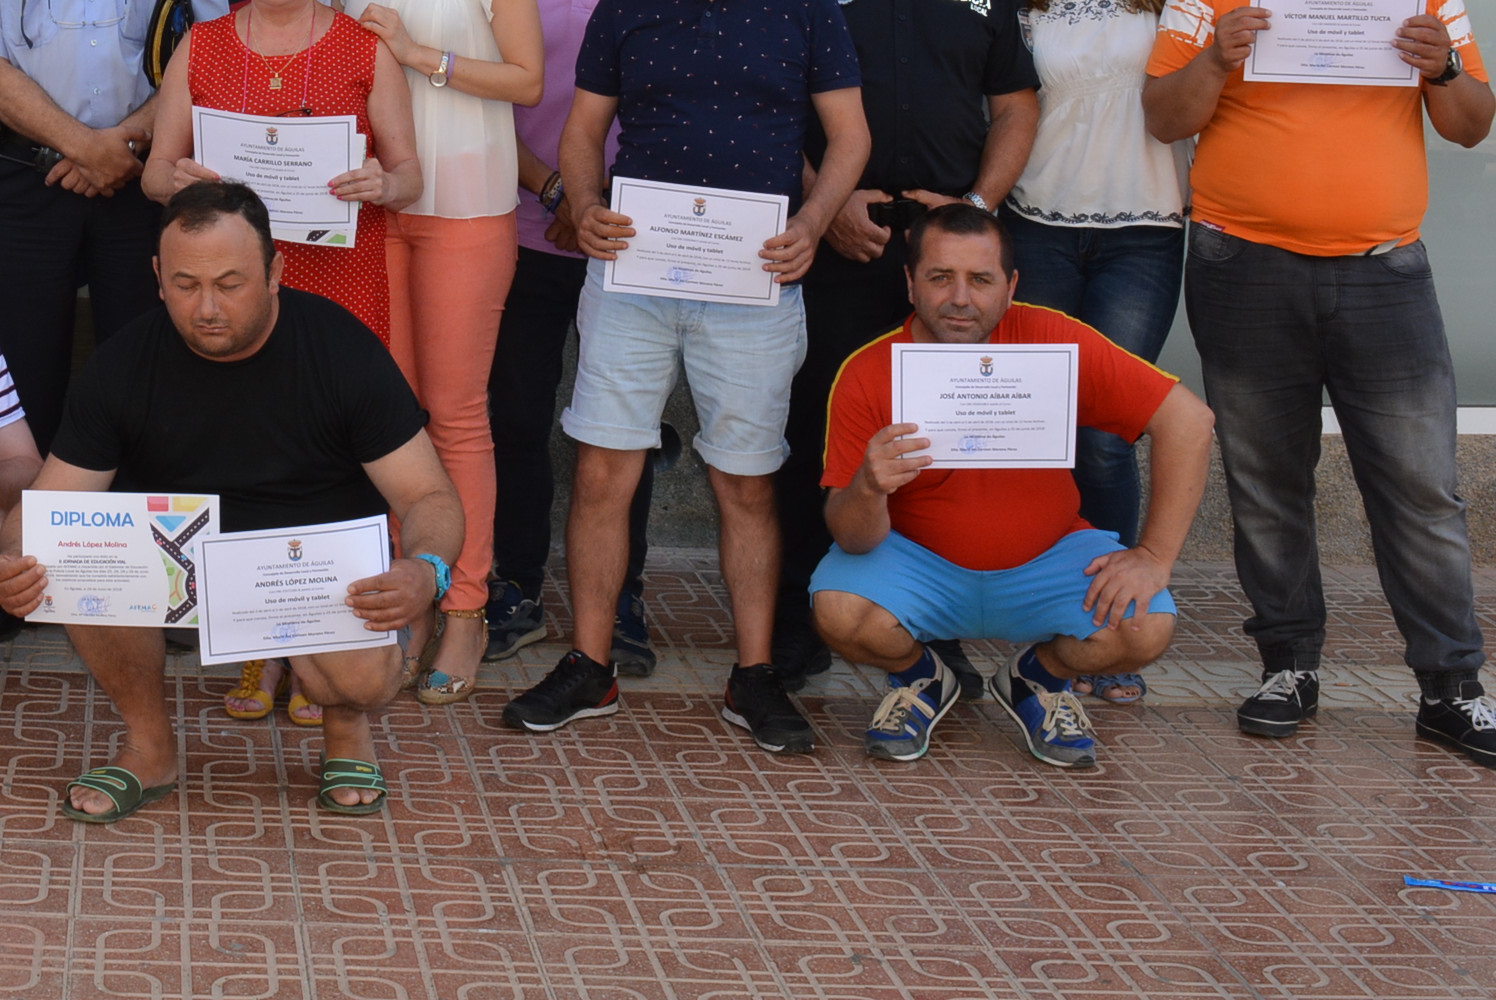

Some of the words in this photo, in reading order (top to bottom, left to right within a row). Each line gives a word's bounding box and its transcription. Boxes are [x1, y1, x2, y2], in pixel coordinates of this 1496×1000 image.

[970, 3, 988, 17] LOCAL
[234, 155, 254, 163] MARÍA
[254, 158, 283, 166] CARRILLO
[283, 159, 313, 168] SERRANO
[650, 226, 680, 235] ALFONSO
[680, 229, 713, 239] MARTÍNEZ
[714, 233, 744, 242] ESCÁMEZ
[940, 392, 956, 400] JOSÉ
[51, 511, 135, 528] DIPLOMA
[82, 541, 103, 549] López
[255, 579, 284, 588] ANDRÉS
[285, 577, 307, 586] LÓPEZ
[308, 576, 339, 584] MOLINA
